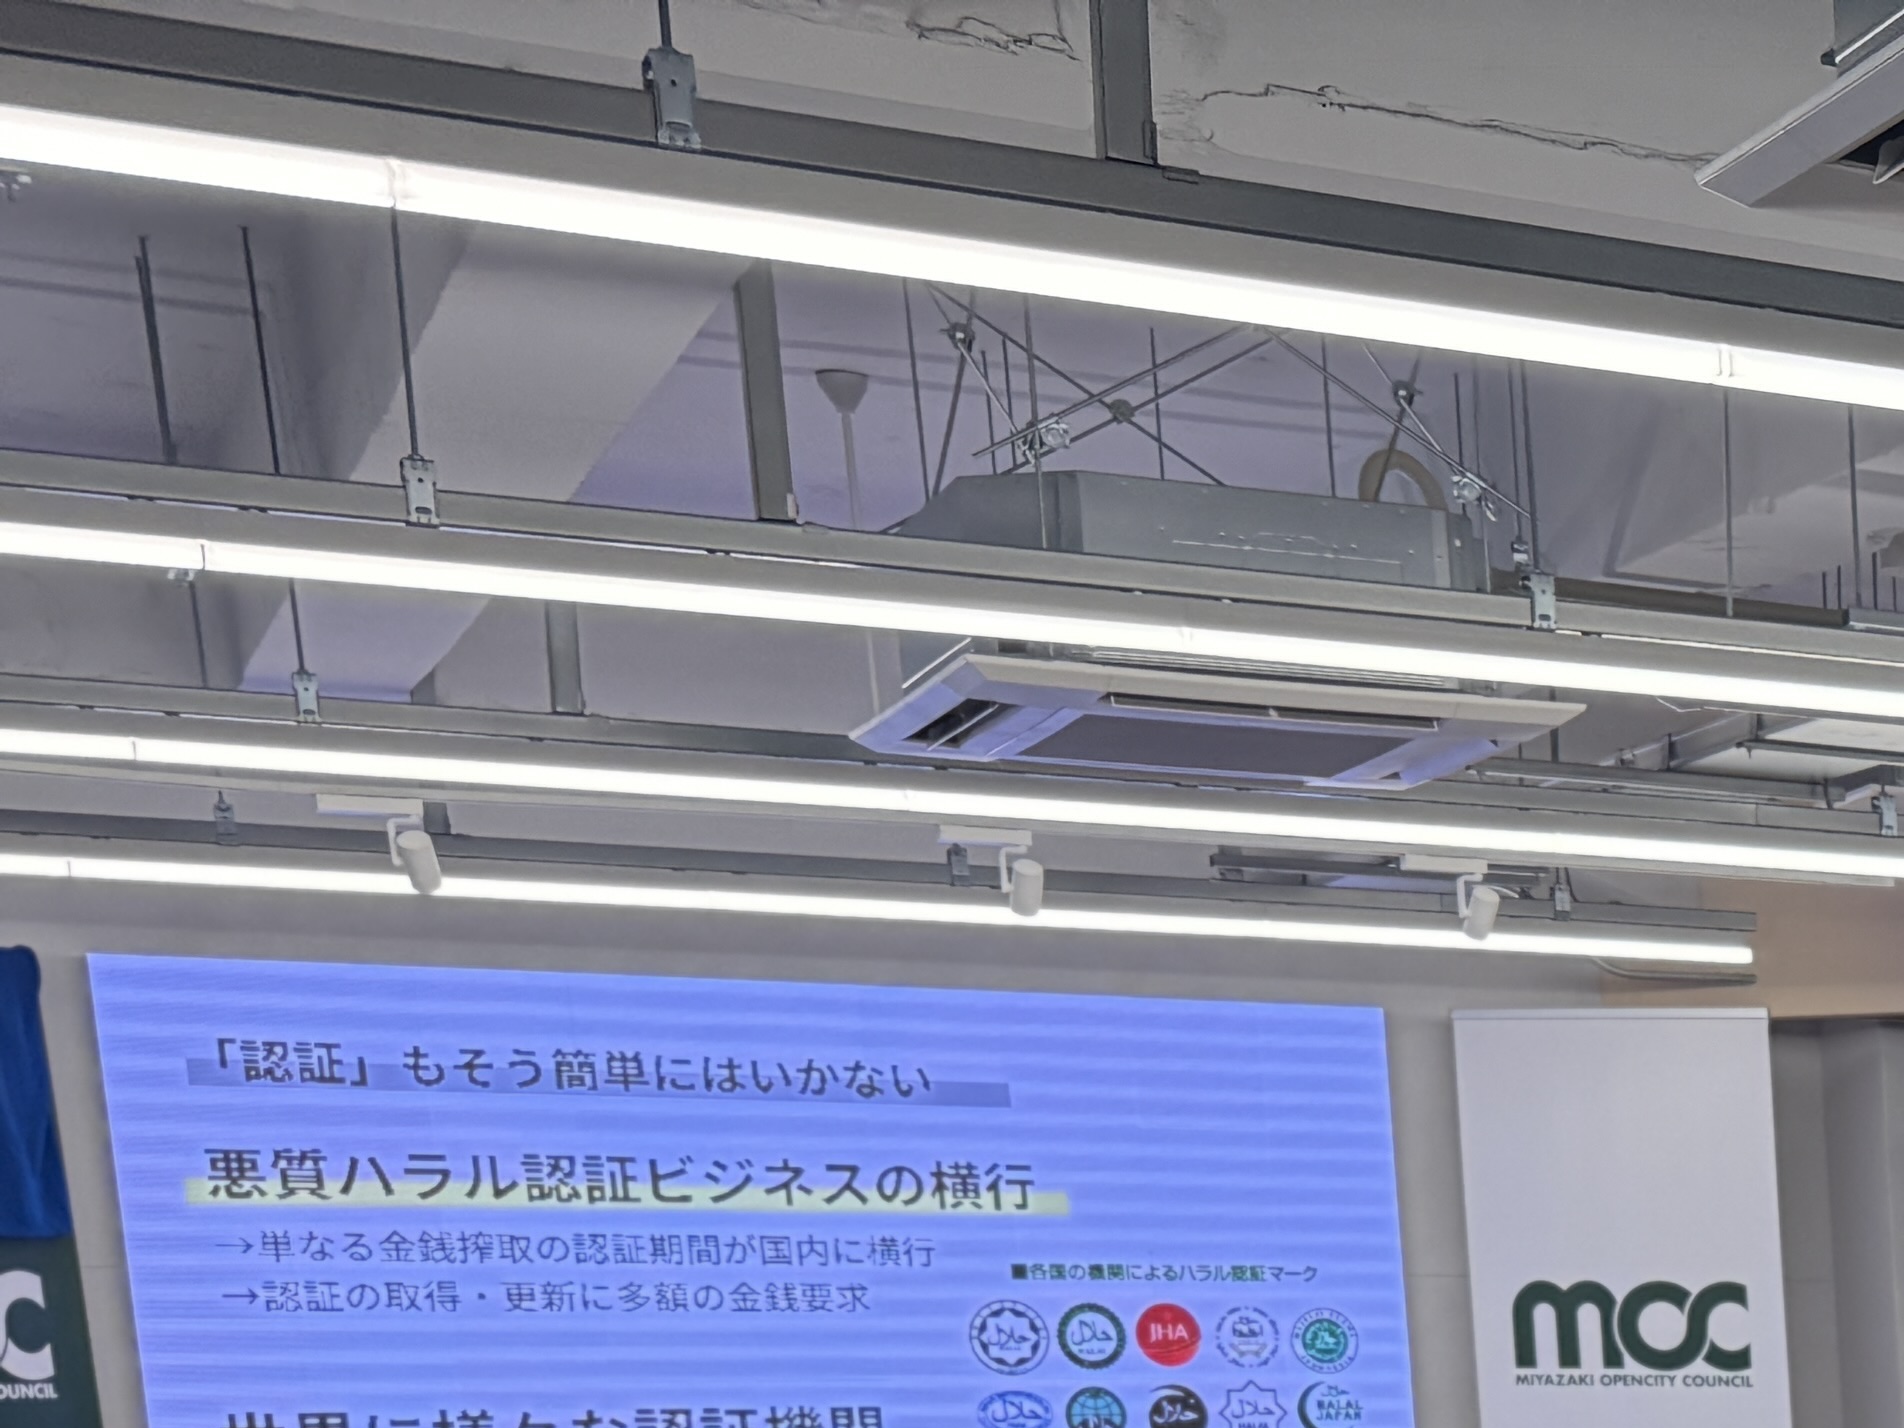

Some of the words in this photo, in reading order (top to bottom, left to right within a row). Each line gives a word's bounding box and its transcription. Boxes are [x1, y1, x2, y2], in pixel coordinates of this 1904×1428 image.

[216, 1037, 932, 1099] 「認証」もそう簡単にはいかない
[203, 1146, 1036, 1211] 悪質ハラル認証ビジネスの横行
[260, 1279, 871, 1314] 認証の取得・更新に多額の金銭要求
[1149, 1324, 1189, 1343] JHA
[0, 1383, 58, 1400] OUNCIL
[1515, 1374, 1595, 1387] MIYAZAKI
[1599, 1374, 1677, 1388] OPENCITY
[1682, 1375, 1754, 1389] COUNCIL
